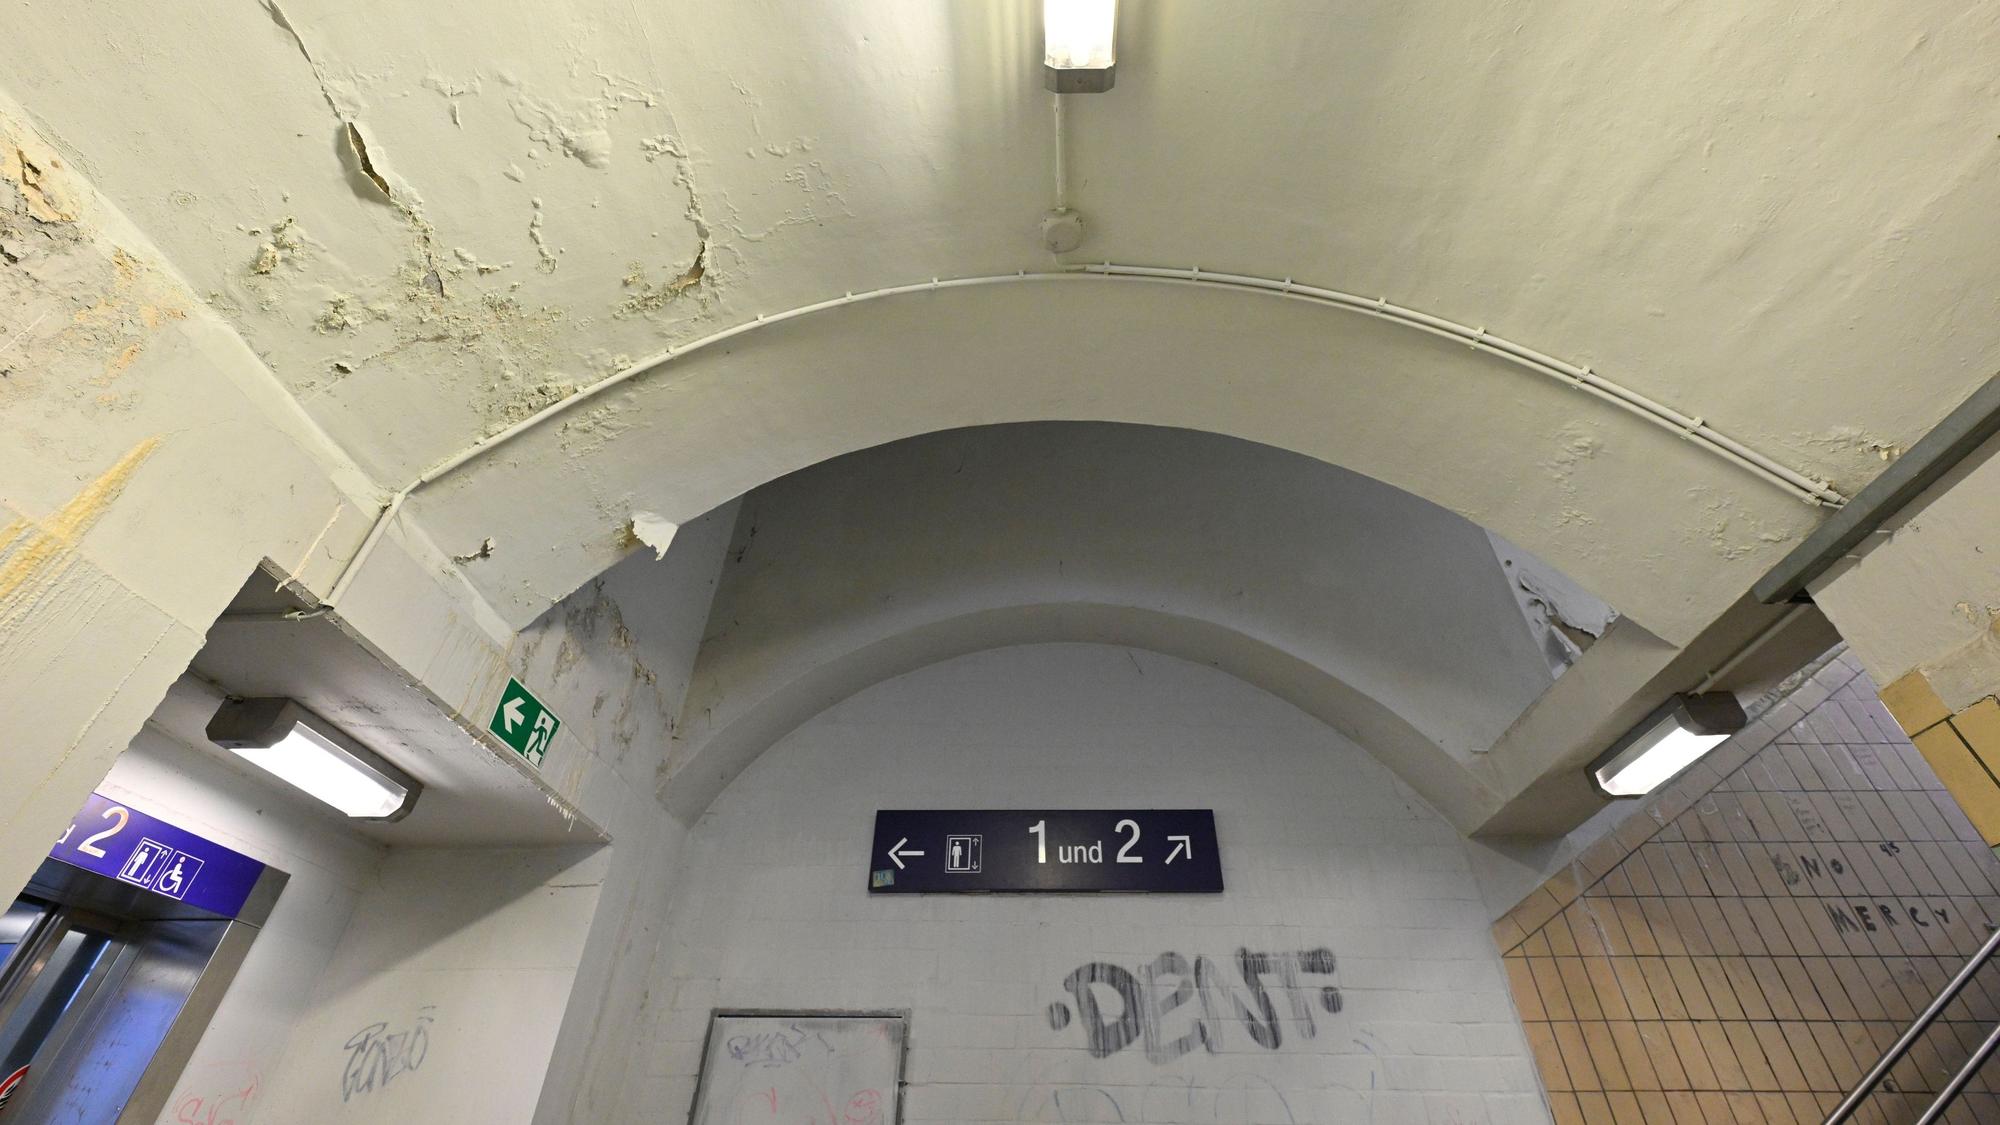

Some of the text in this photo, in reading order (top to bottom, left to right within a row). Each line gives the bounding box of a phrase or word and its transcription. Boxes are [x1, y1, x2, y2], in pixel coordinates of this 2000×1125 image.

[77, 806, 129, 858] 2
[1028, 818, 1143, 863] 1 und 2
[1826, 903, 1949, 935] MERCY
